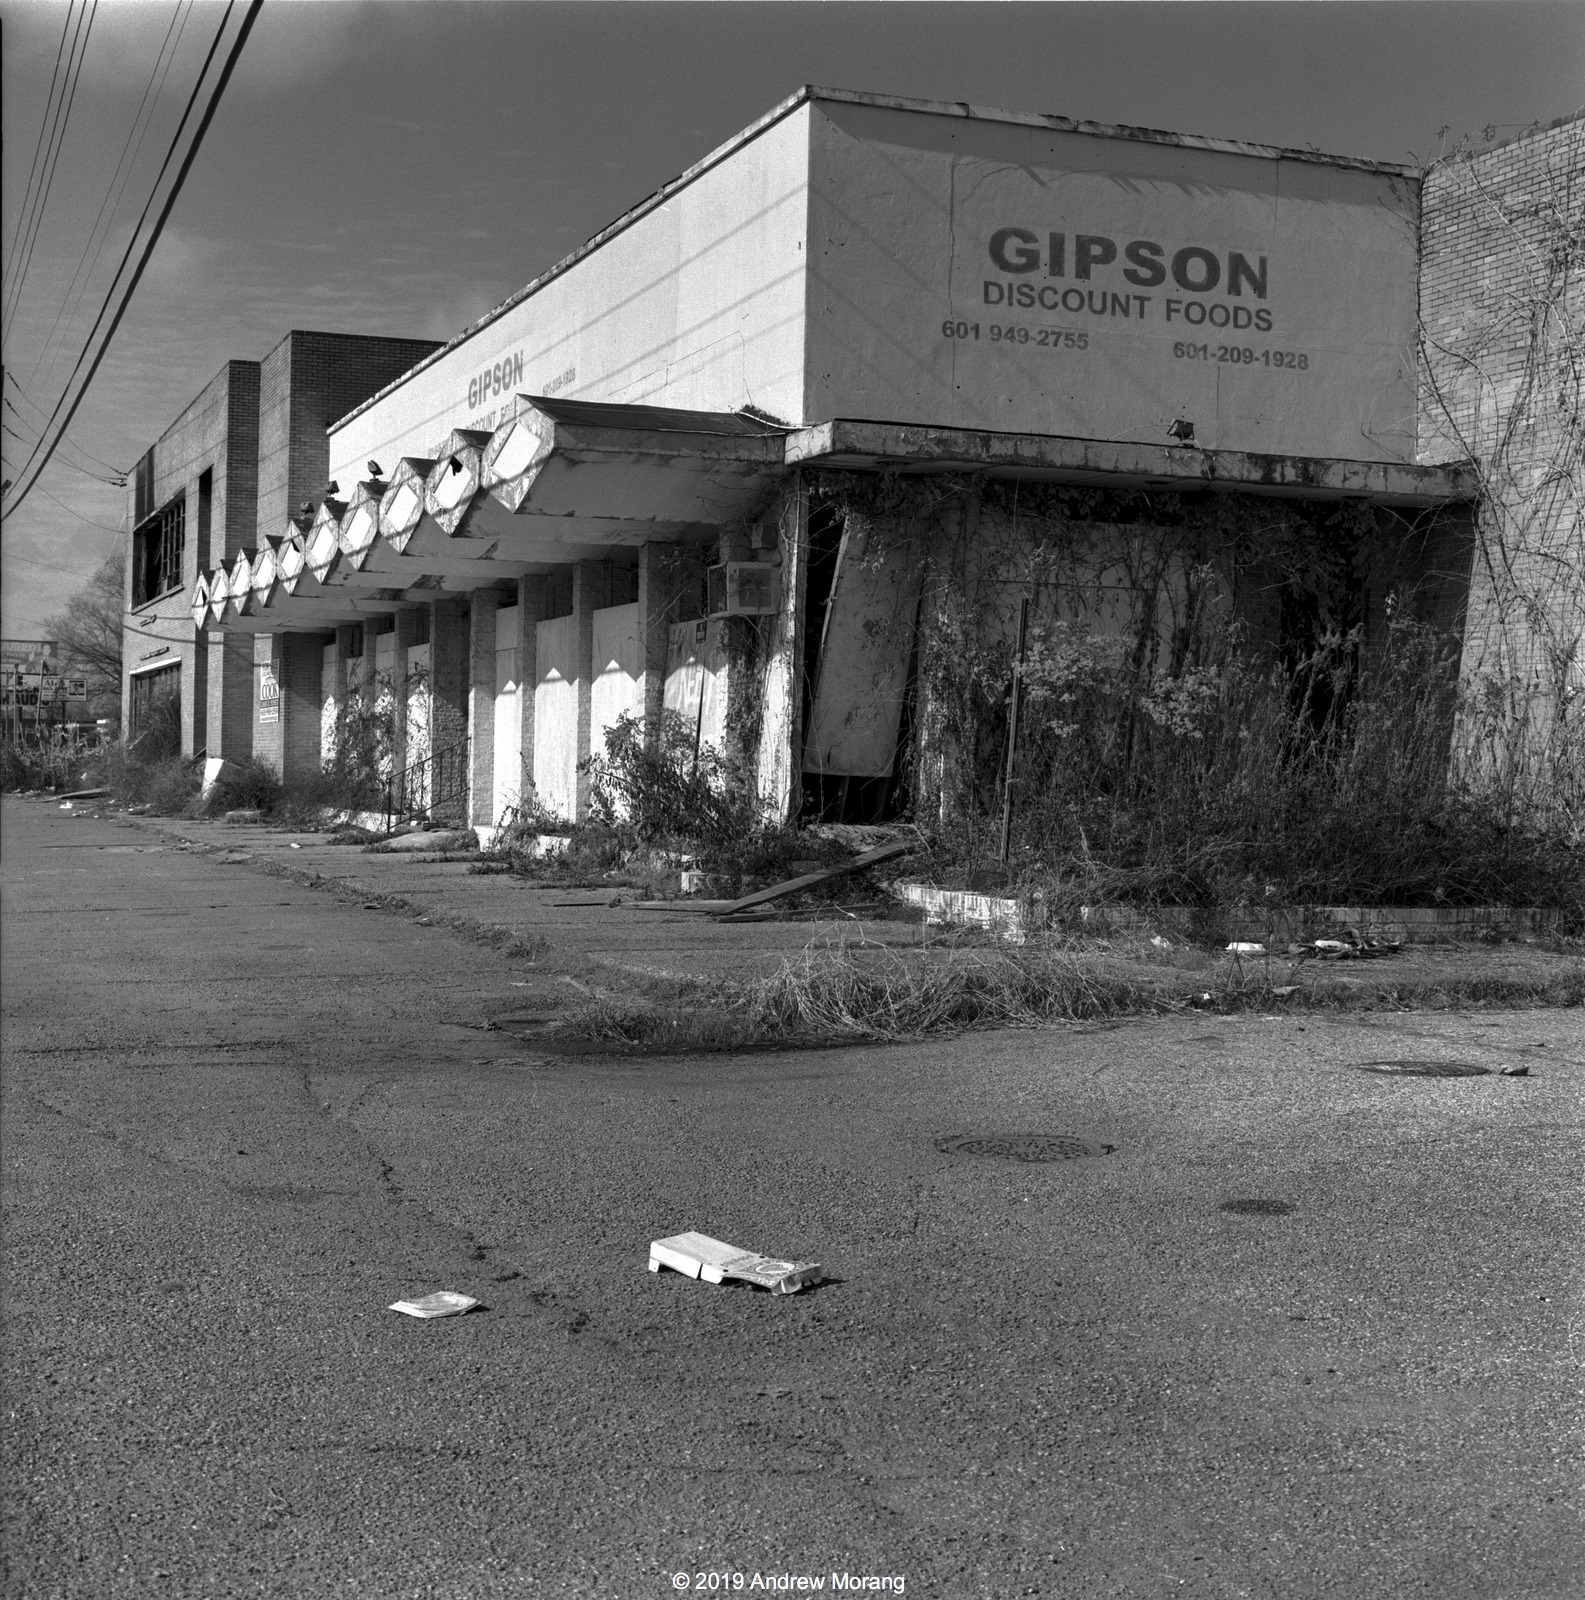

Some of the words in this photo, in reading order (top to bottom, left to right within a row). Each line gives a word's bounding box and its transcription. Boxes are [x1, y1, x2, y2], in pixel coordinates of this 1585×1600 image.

[988, 227, 1268, 299] GIPSON
[983, 281, 1152, 319] DISCOUNT
[1165, 298, 1273, 332] FOODS
[942, 320, 980, 340] 601
[990, 324, 1089, 350] 949-2755
[1173, 341, 1309, 370] 601-209-1928
[468, 349, 524, 409] GIPSON
